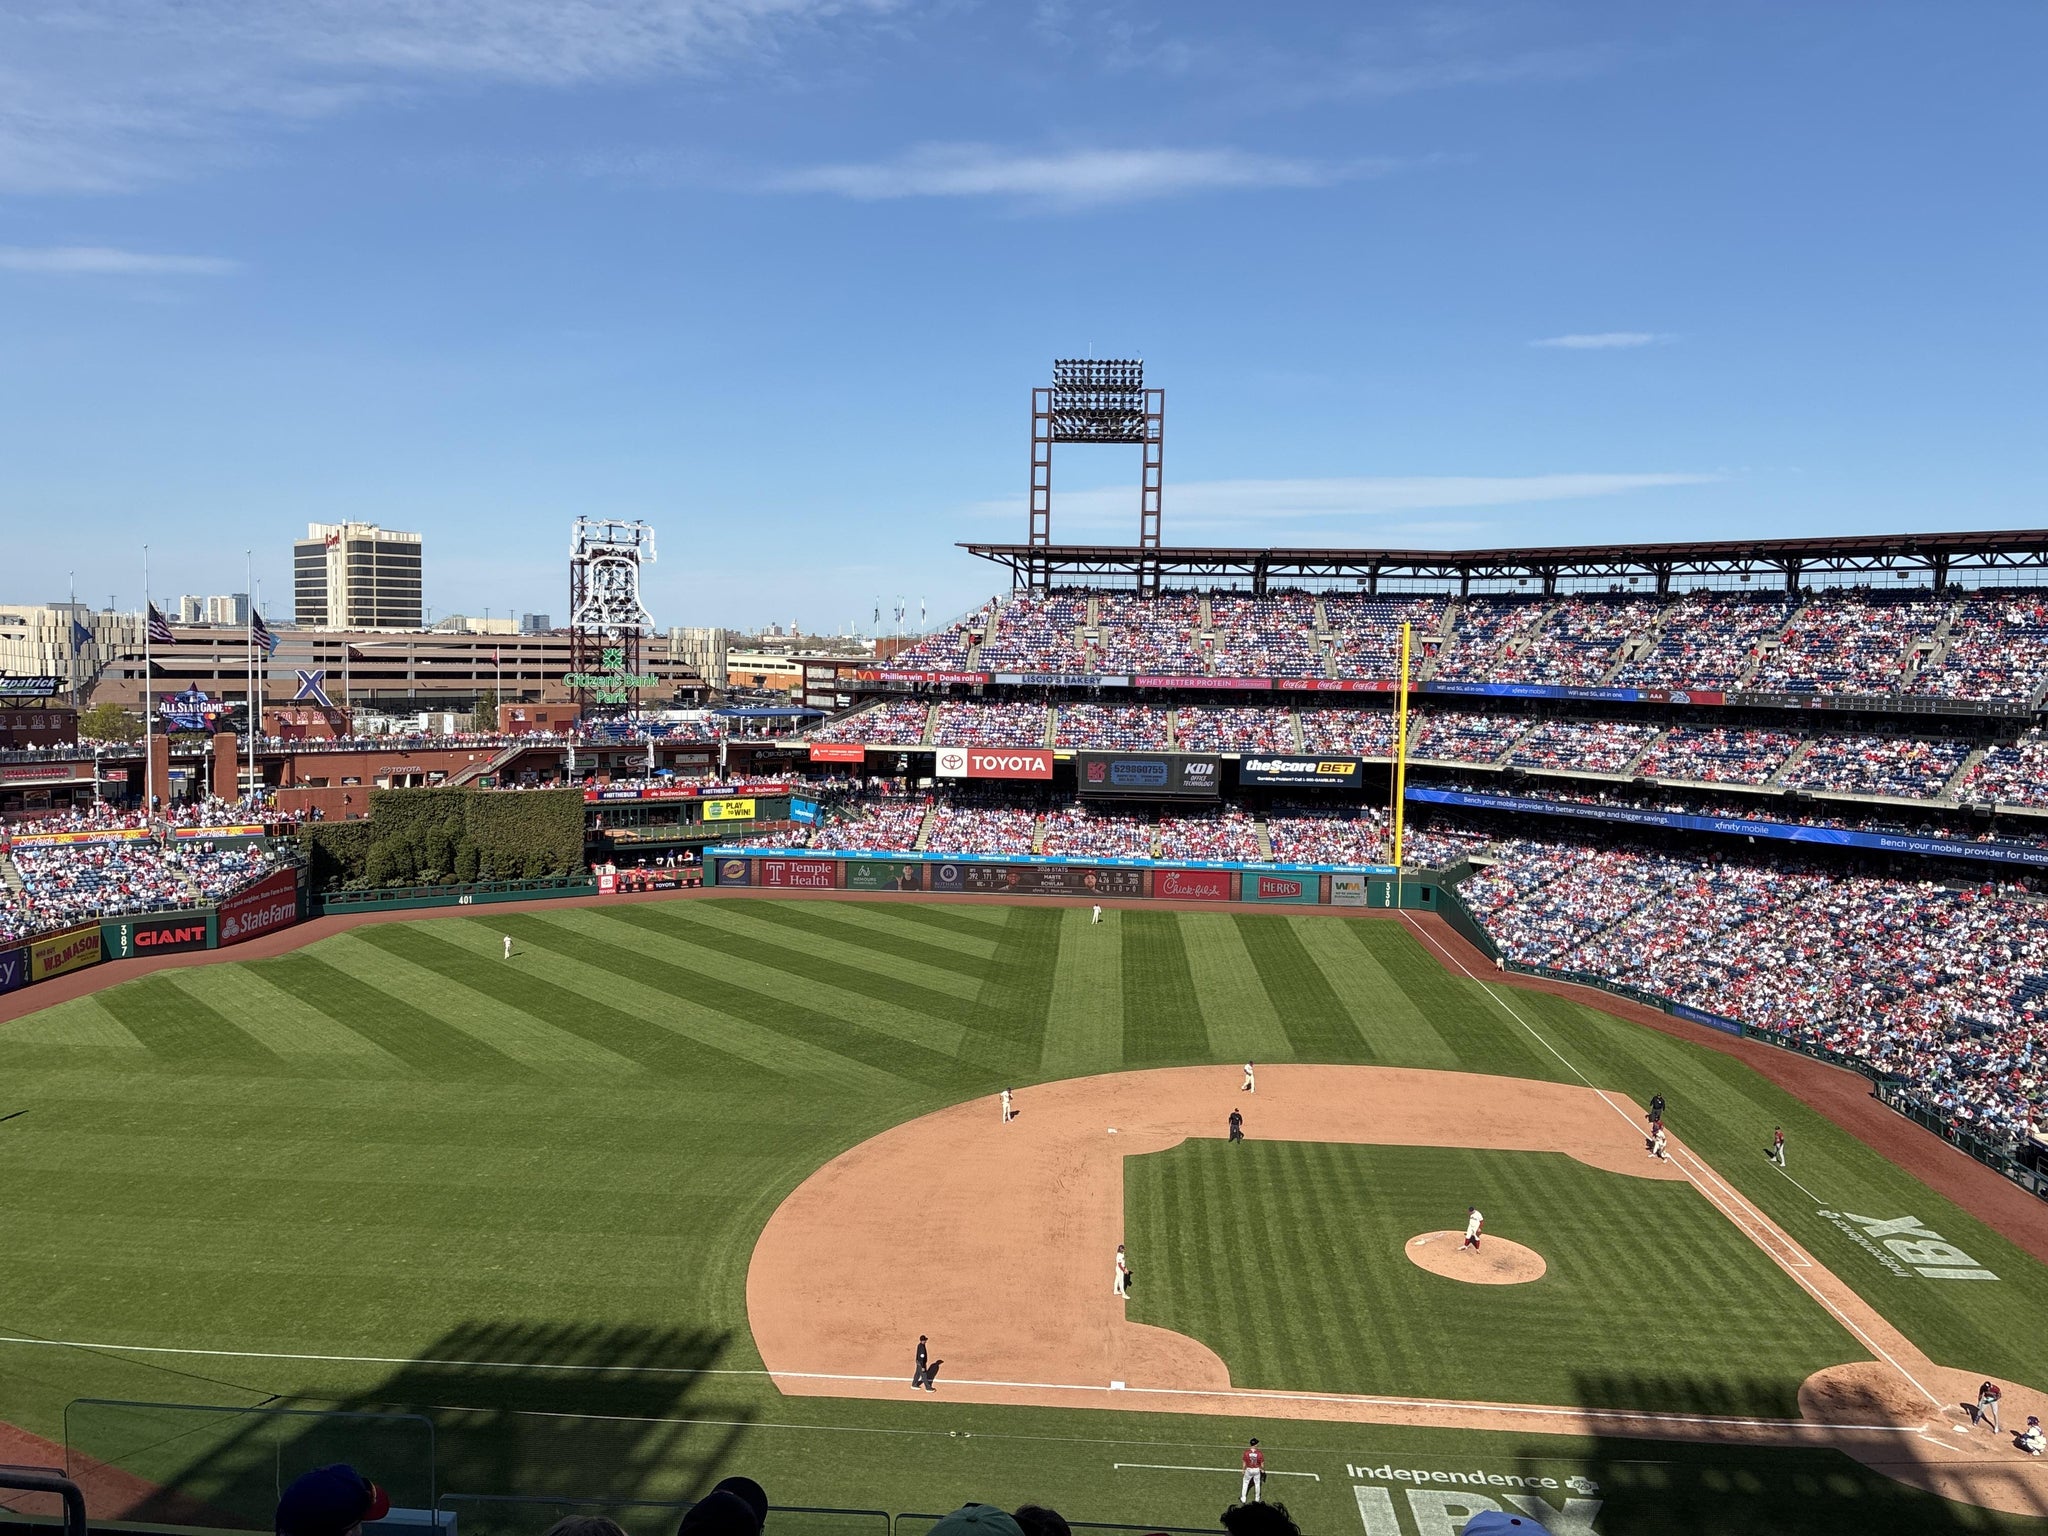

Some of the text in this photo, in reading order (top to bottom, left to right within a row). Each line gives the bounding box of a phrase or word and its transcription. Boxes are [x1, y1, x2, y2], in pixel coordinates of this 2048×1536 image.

[563, 673, 659, 687] Citizens Bank
[880, 672, 908, 681] Phillies
[940, 674, 960, 682] Deals
[1022, 675, 1102, 685] LISCIO'S BAKERY
[1166, 679, 1194, 687] BETTER
[596, 689, 628, 704] Park
[159, 702, 177, 712] ALL
[200, 702, 224, 712] GAME
[971, 755, 1047, 772] TOYOTA
[1245, 759, 1353, 773] theScore BET
[754, 785, 783, 793] Budweiser
[725, 801, 744, 810] PLAY
[1463, 796, 1482, 804] Bench
[1482, 799, 1496, 807] your
[1497, 800, 1517, 808] mobile
[1518, 802, 1544, 811] provider
[1545, 804, 1555, 812] for
[1555, 805, 1575, 814] better
[1576, 808, 1606, 818] coverage
[1621, 812, 1641, 821] bigger
[1643, 815, 1670, 824] savings.
[734, 808, 751, 816] WIN!
[1715, 821, 1769, 834] xfinity mobile
[87, 832, 122, 843] Surfside
[195, 829, 227, 839] Surfside
[19, 837, 55, 847] Surfside
[1880, 837, 1907, 848] Bench
[1909, 841, 1930, 851] your
[1931, 843, 1962, 854] mobile
[1964, 847, 2004, 858] provider
[2006, 850, 2021, 859] for
[790, 862, 832, 875] Temple
[790, 875, 829, 886] Health
[1262, 881, 1297, 894] HERR'S
[1335, 882, 1360, 891] WM
[458, 895, 473, 905] 401
[120, 924, 128, 957] 387
[134, 926, 205, 946] GIANT
[1345, 1463, 1559, 1490] Independence
